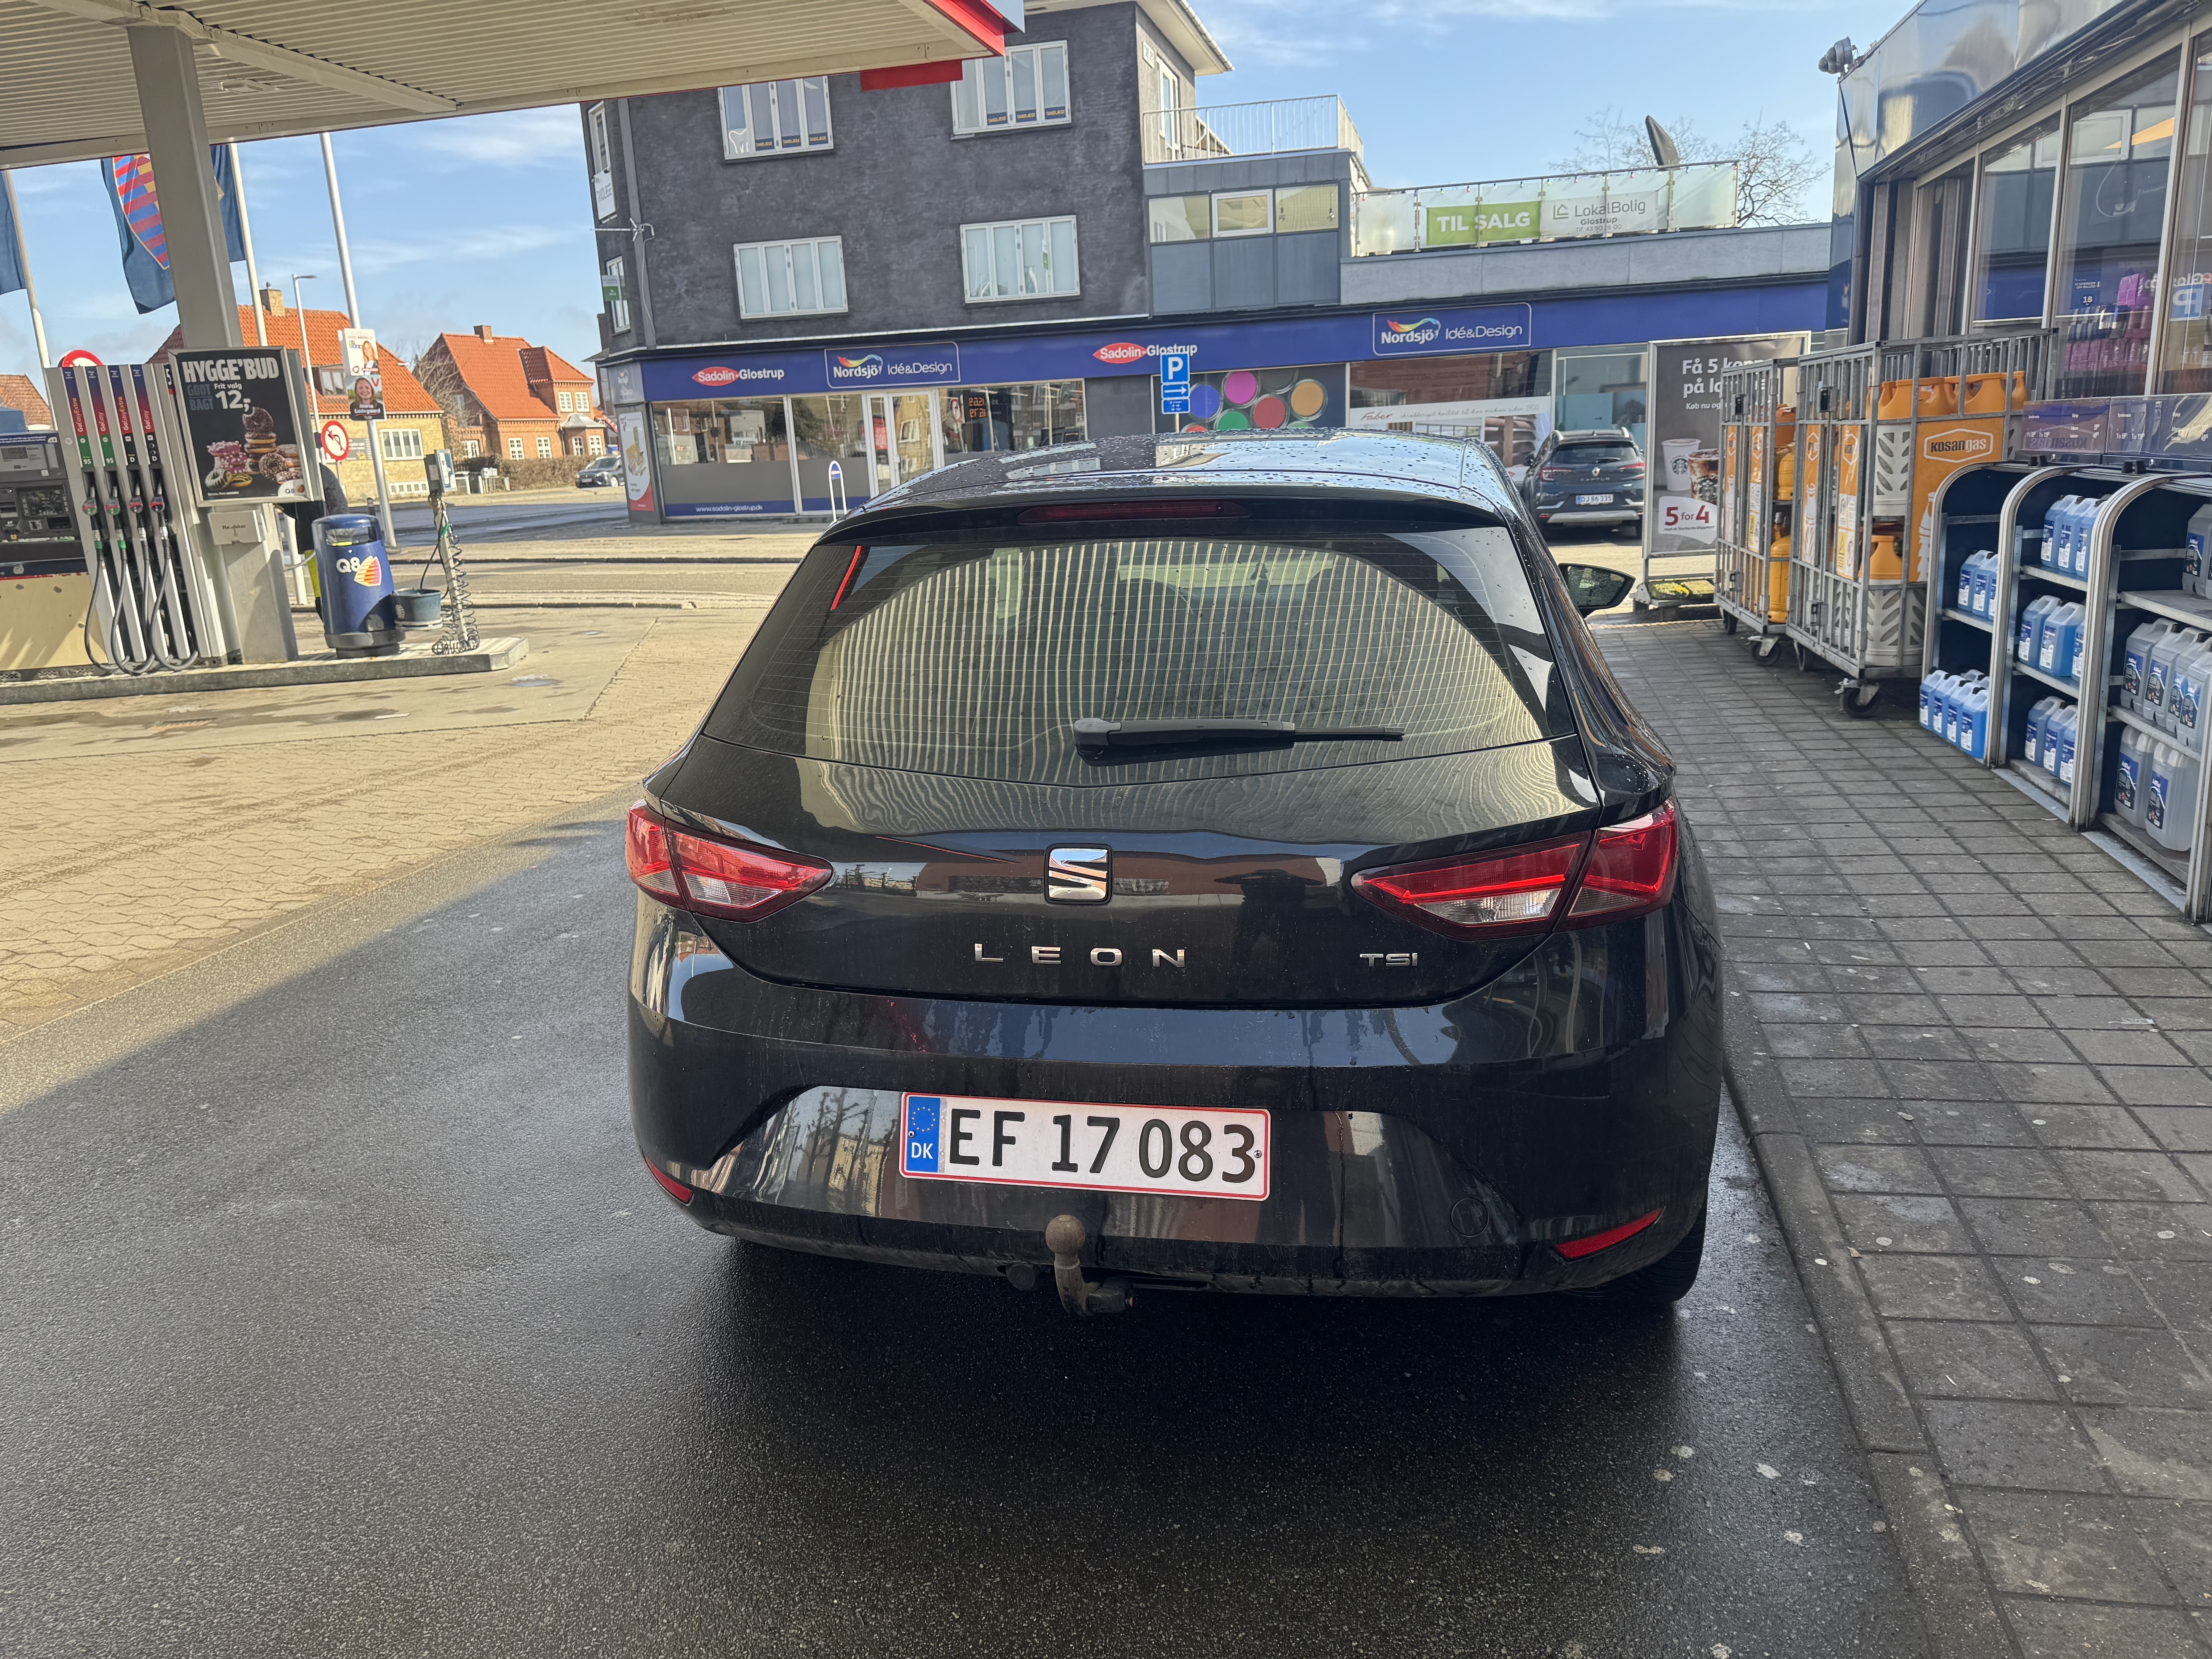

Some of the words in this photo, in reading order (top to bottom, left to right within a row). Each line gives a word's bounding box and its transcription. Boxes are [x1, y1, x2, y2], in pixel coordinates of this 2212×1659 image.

[1575, 199, 1645, 216] LokalBolig
[1437, 215, 1469, 232] TIL
[1474, 212, 1530, 230] SALG
[1381, 330, 1434, 344] Nordsjö
[1446, 325, 1522, 339] Idé&Design
[182, 357, 279, 383] HYGGE'BUD
[833, 365, 878, 379] Nordsjö
[888, 362, 952, 375] Idé&Design
[1168, 357, 1183, 380] P
[1682, 358, 1702, 374] Få
[1707, 359, 1718, 373] 5
[166, 369, 172, 386] 5
[371, 377, 379, 386] V
[187, 384, 210, 396] GODT
[1683, 378, 1704, 398] på
[189, 398, 213, 410] BAGT
[98, 412, 106, 431] GoEasy
[1361, 412, 1393, 421] Faber
[1665, 507, 1678, 526] 5
[1681, 512, 1695, 520] for
[1696, 505, 1709, 523] 4
[336, 557, 361, 573] Q8
[975, 943, 1185, 967] LEON
[1360, 953, 1417, 967] TSI
[911, 1142, 933, 1160] DK
[949, 1108, 1025, 1166] EF
[1051, 1115, 1120, 1173] 17
[1139, 1119, 1256, 1183] 083
